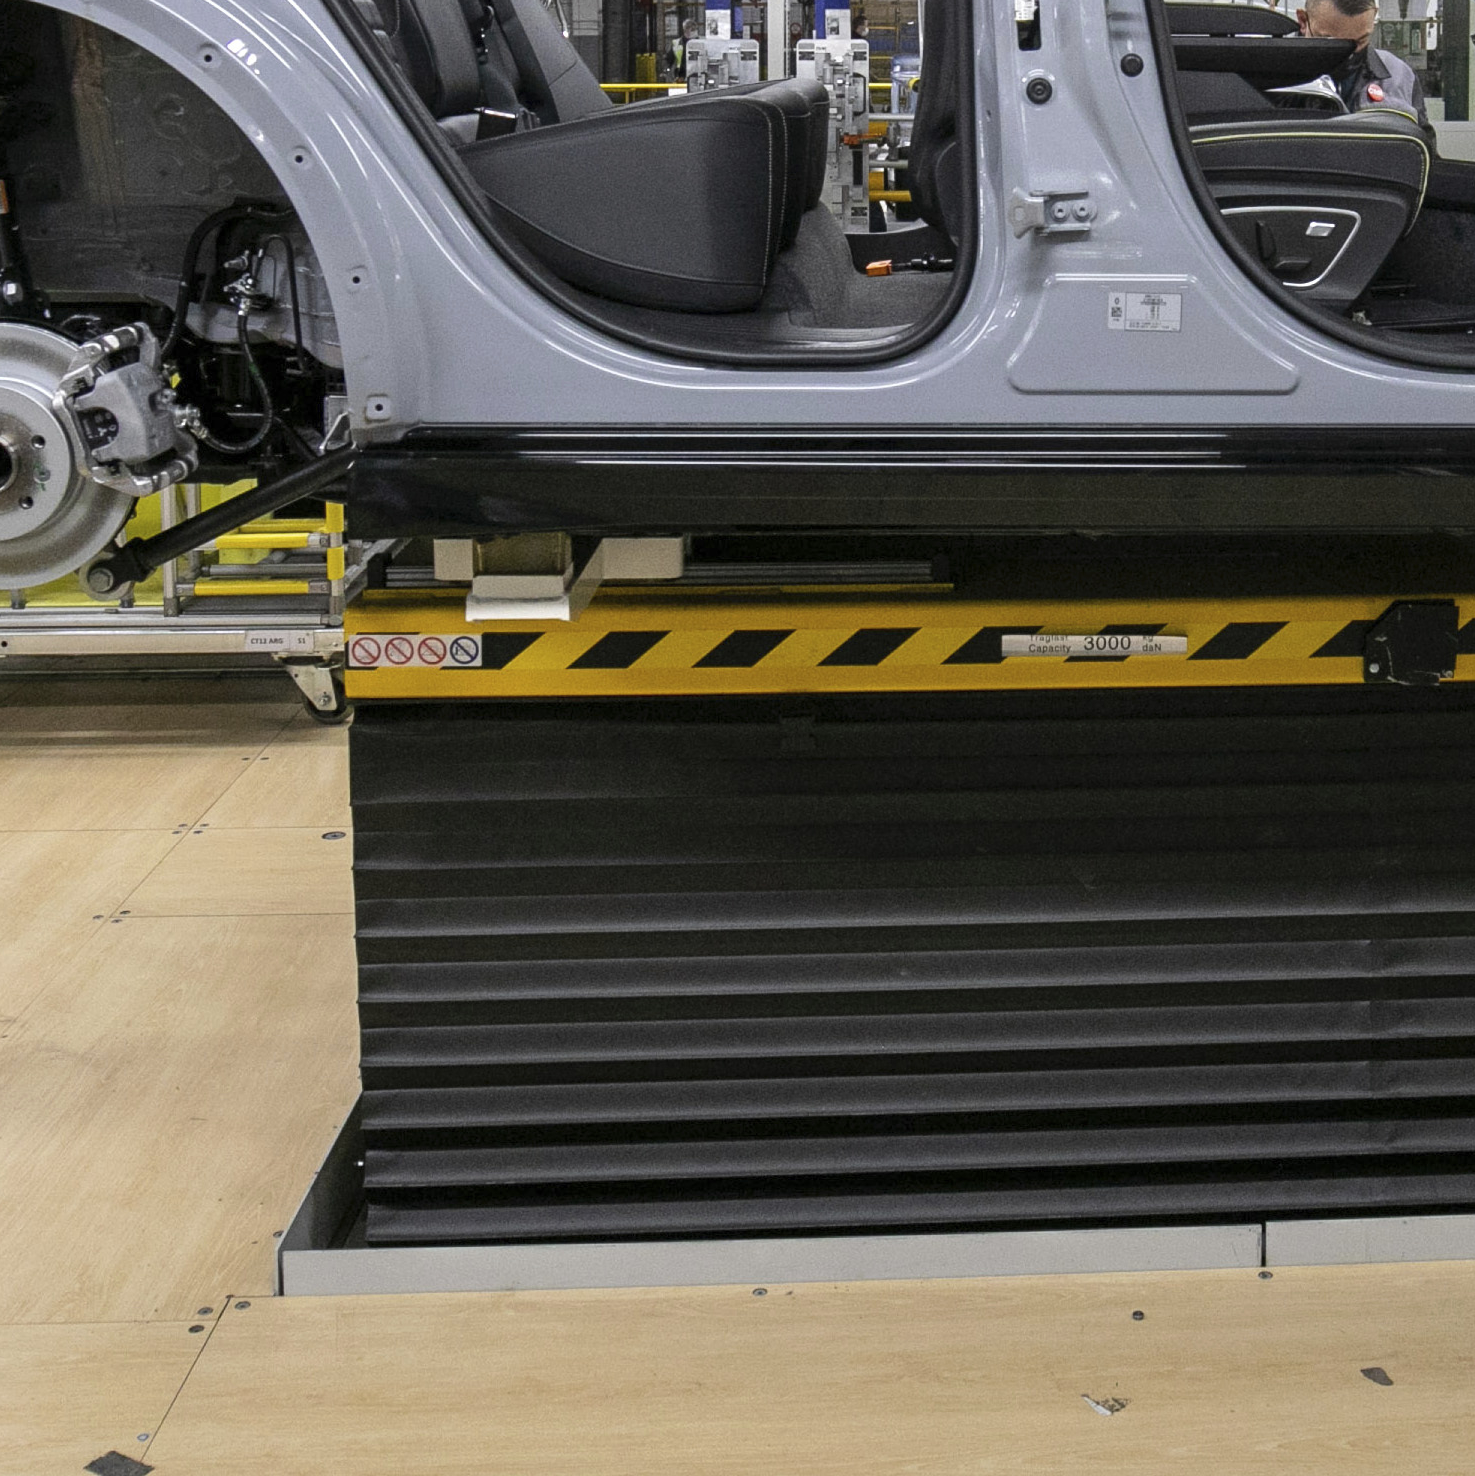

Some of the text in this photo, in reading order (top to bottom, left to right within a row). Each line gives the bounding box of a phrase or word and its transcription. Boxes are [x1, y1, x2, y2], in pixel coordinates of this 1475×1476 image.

[1028, 643, 1162, 654] Capacity daN
[1083, 636, 1131, 651] 3000
